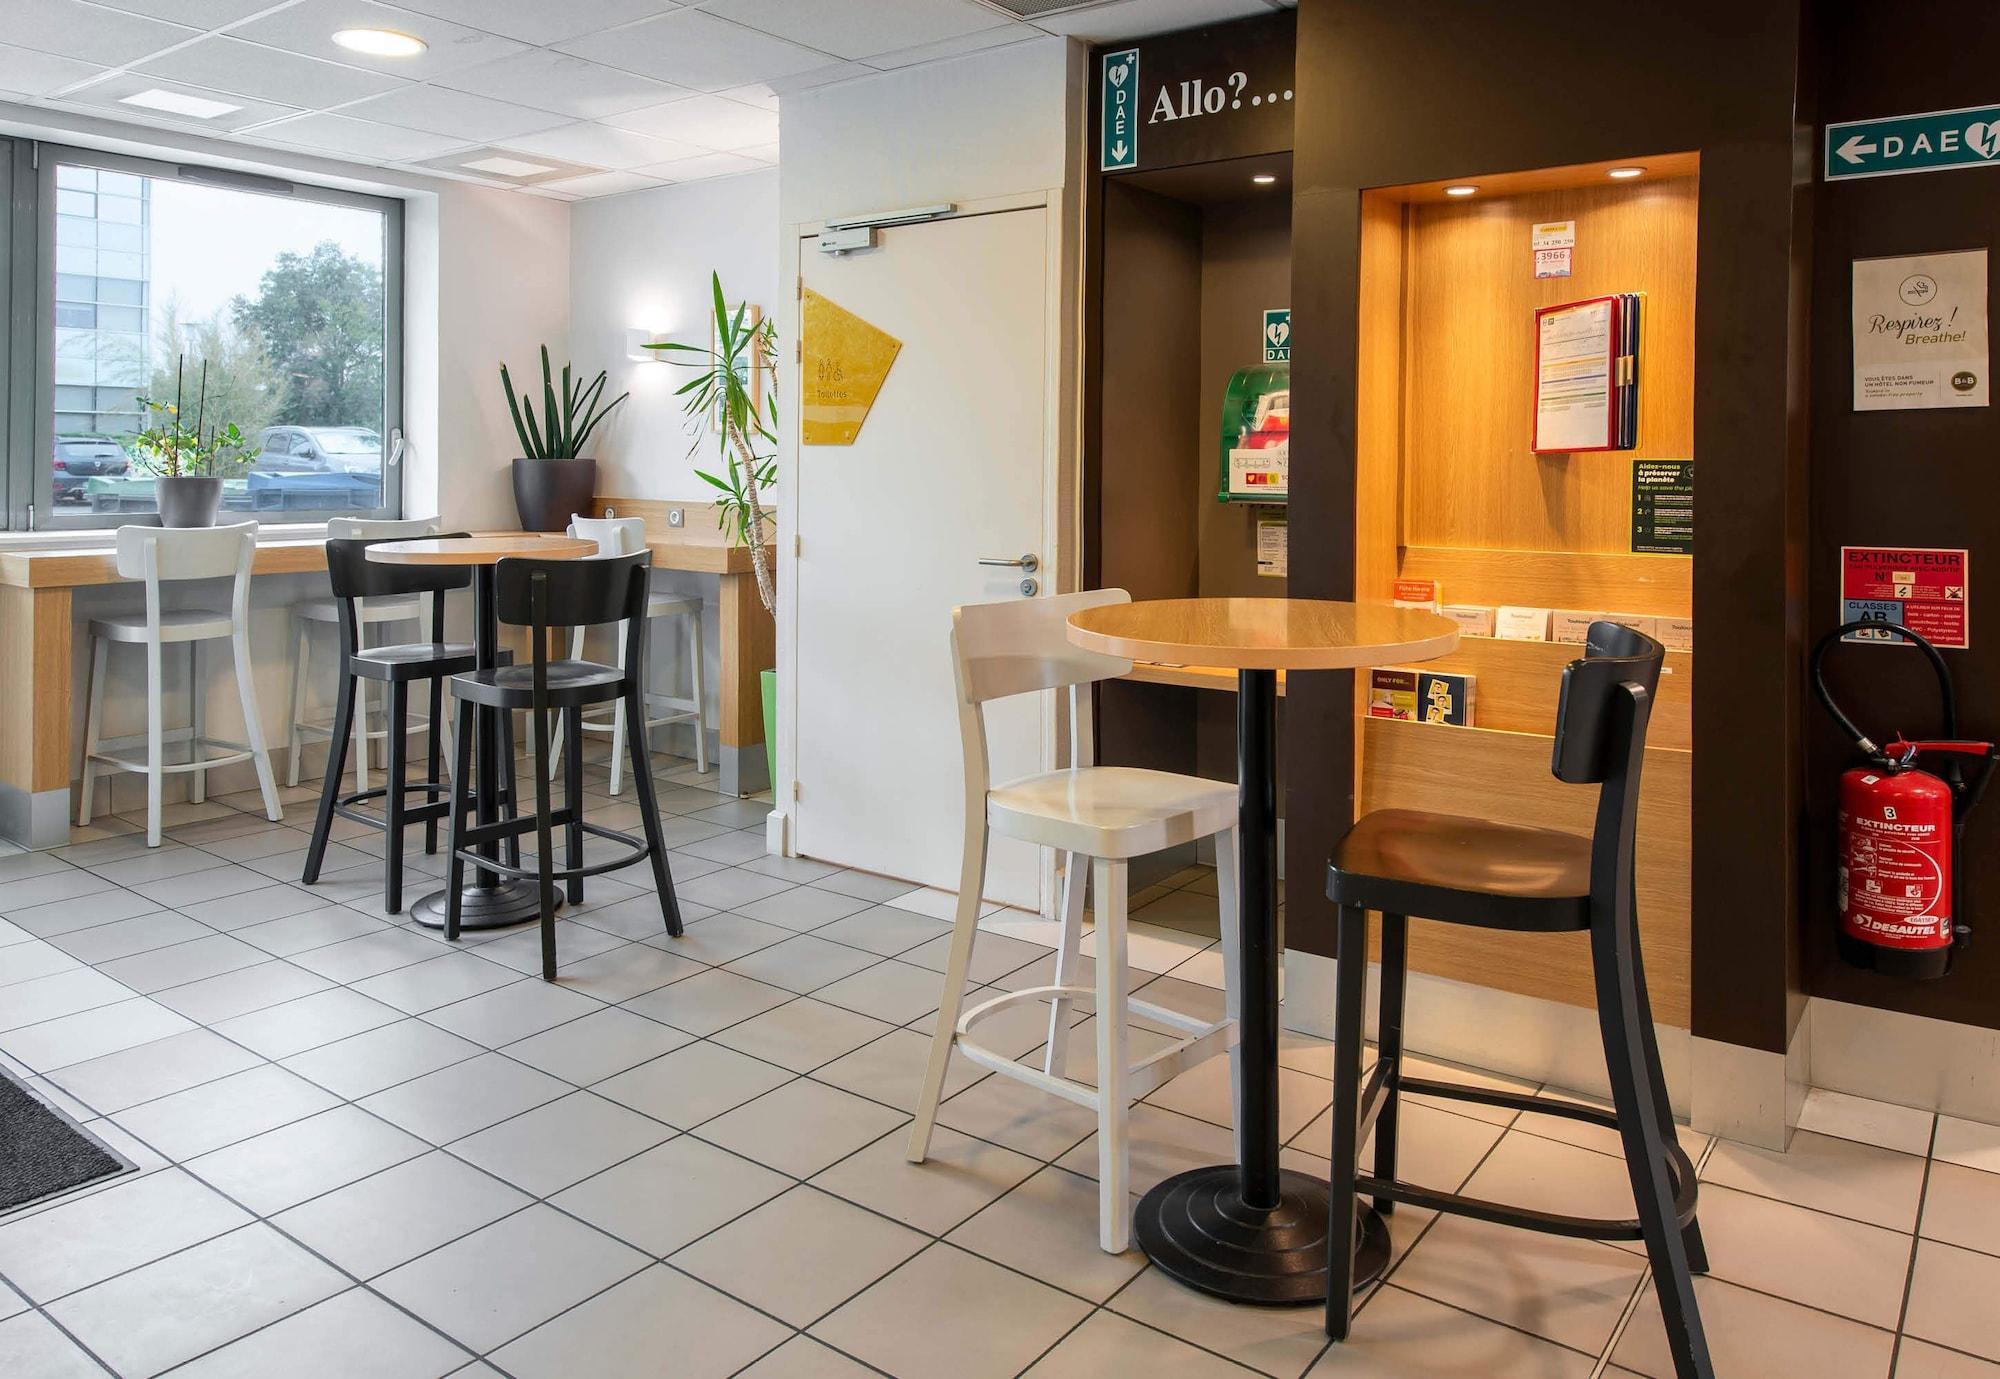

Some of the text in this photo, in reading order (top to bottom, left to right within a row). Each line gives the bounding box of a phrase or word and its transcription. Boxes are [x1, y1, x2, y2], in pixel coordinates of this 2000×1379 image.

[1115, 90, 1127, 135] DAE
[1883, 129, 1960, 158] DAE
[1868, 306, 1958, 339] Respirez !
[1905, 331, 1966, 345] Breathe!
[818, 390, 847, 398] Toilettes
[1848, 552, 1960, 565] EXTINCTEUR
[1849, 602, 1897, 611] CLASSES
[1885, 807, 1895, 818] 3
[1856, 817, 1936, 832] EXTINCTEUR
[1872, 921, 1936, 935] DESAUTEL
